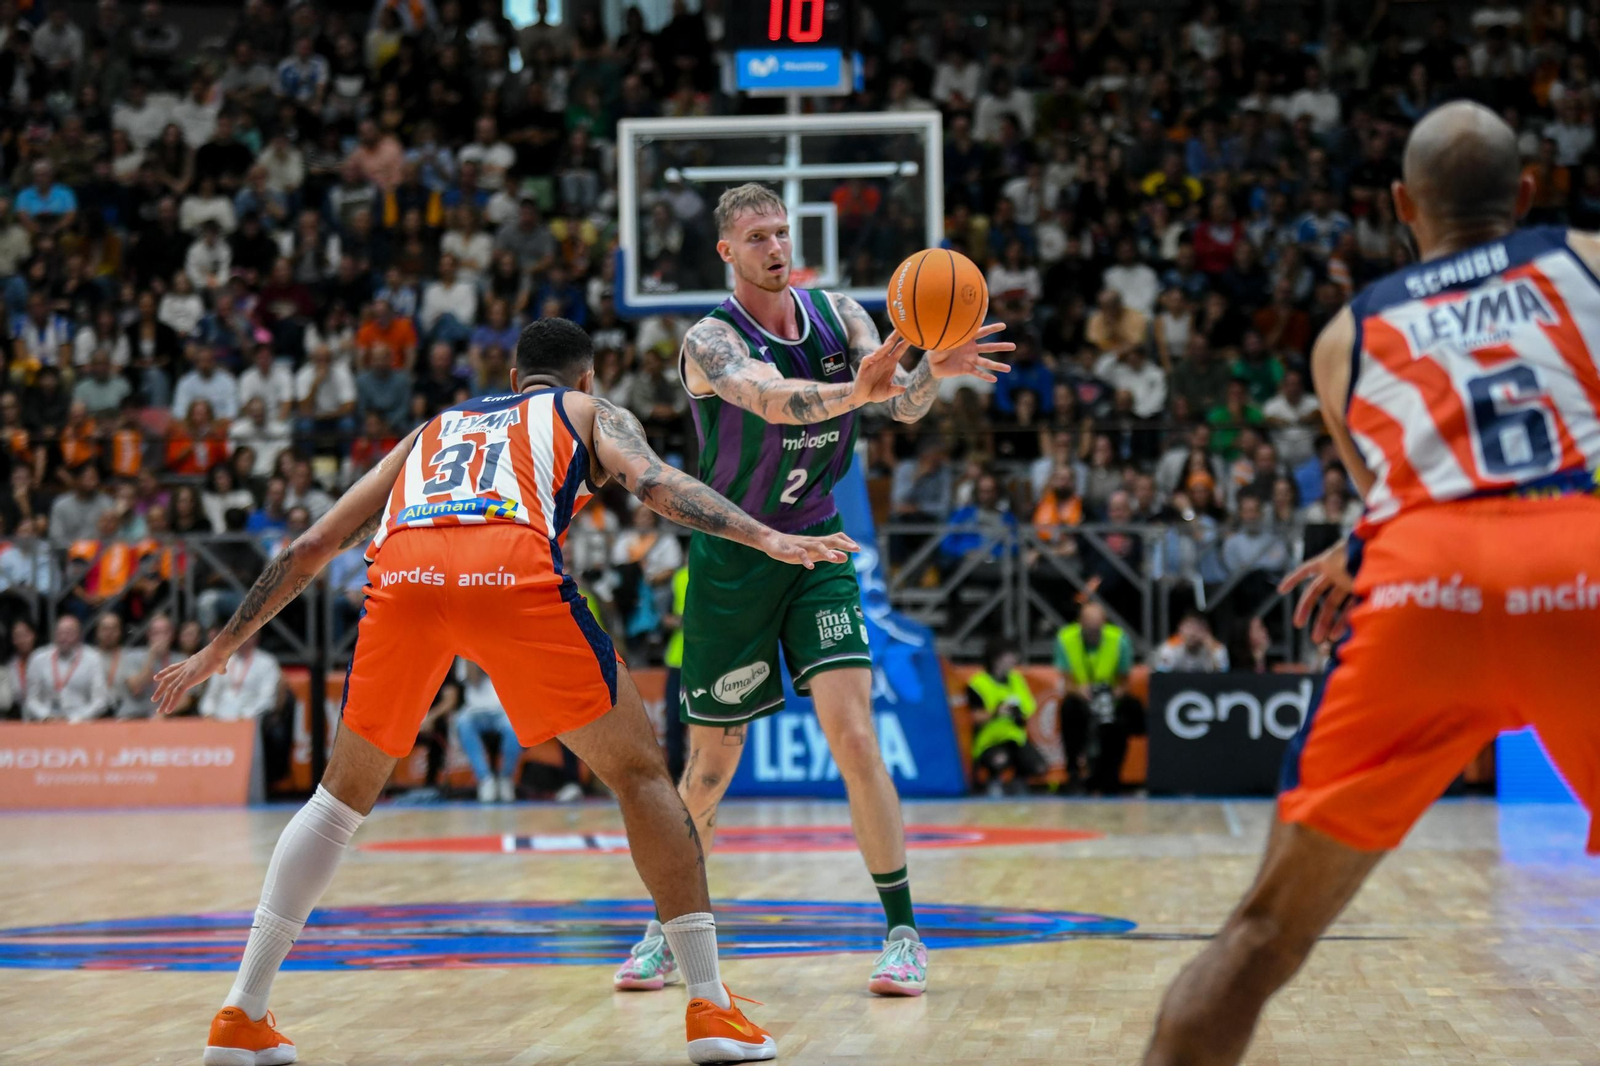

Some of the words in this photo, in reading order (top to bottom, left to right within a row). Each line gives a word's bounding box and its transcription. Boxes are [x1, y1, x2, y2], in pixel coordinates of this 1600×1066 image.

[1409, 282, 1553, 353] LEYMA
[438, 407, 521, 439] LEYMA
[1467, 364, 1555, 475] 6
[421, 440, 511, 496] 31
[780, 468, 808, 504] 2
[403, 501, 476, 520] Aluman
[380, 566, 445, 589] Nordés
[458, 566, 516, 586] ancín
[753, 710, 919, 782] LEYA
